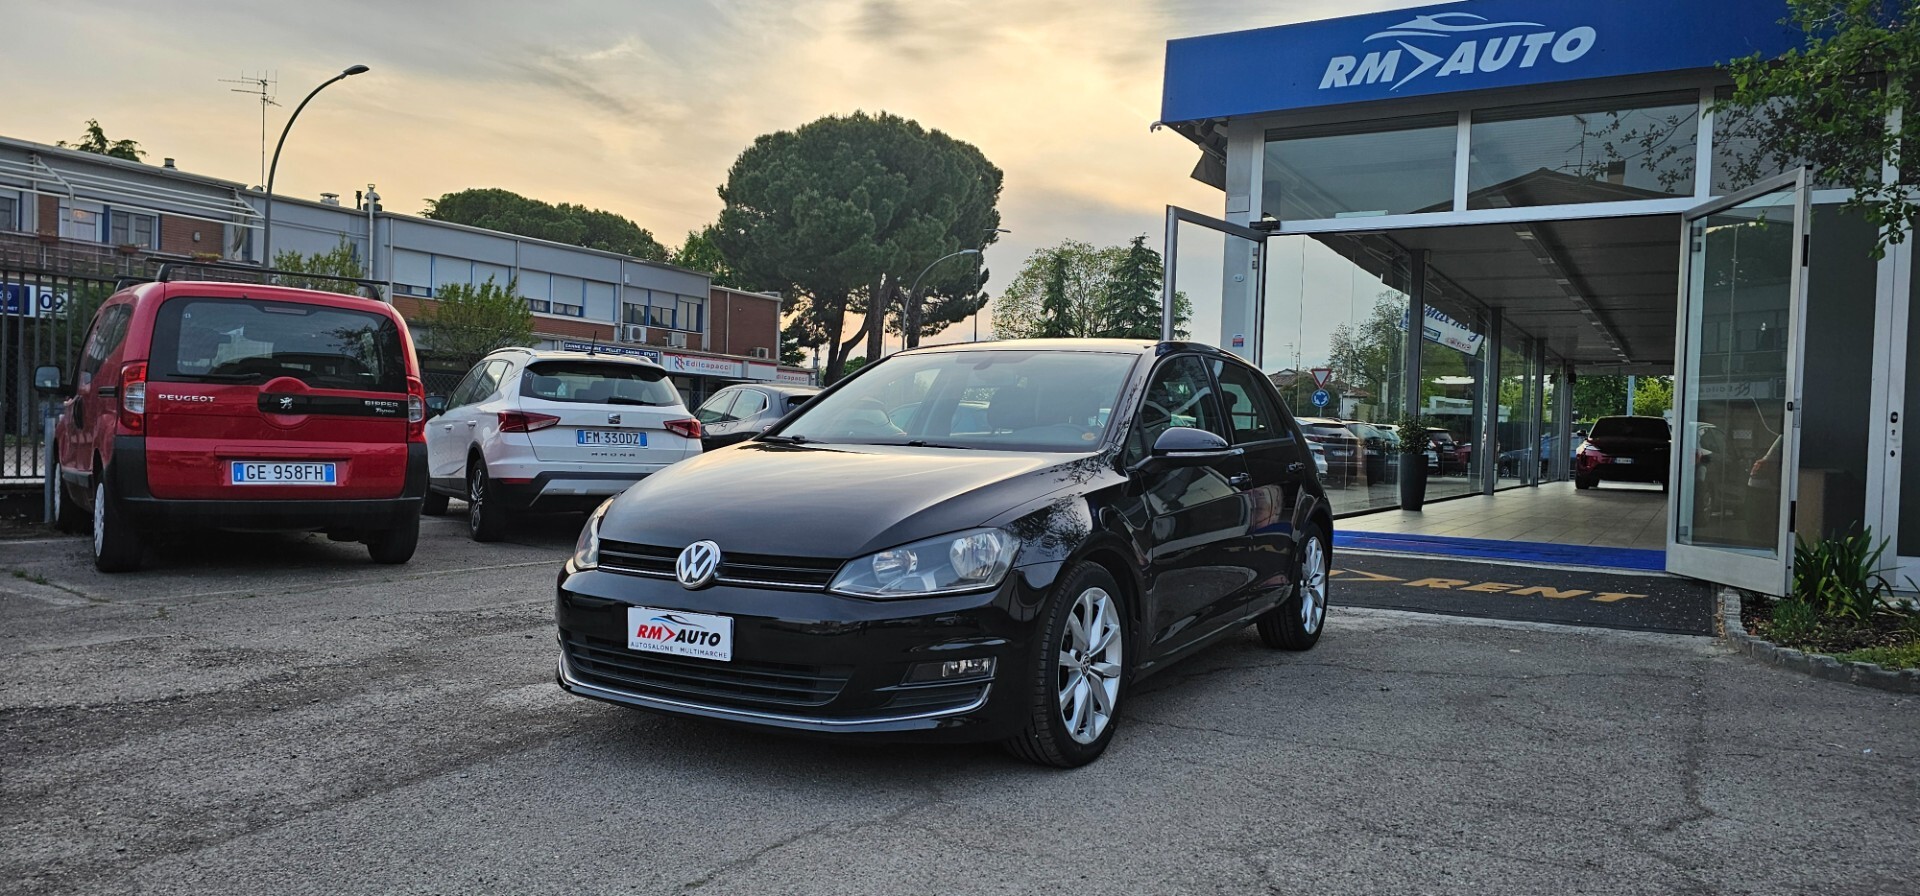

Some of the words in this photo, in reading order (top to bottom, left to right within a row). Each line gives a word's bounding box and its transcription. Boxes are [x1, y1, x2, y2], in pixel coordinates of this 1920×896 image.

[1318, 49, 1402, 90] RM
[1435, 26, 1597, 78] AUTO
[158, 393, 216, 403] PEUGEOT
[585, 431, 600, 443] FM
[604, 432, 639, 445] 330DZ
[246, 464, 267, 480] GE
[273, 464, 324, 481] 958FH
[1402, 577, 1649, 602] RENT
[636, 624, 663, 640] RM
[674, 628, 721, 647] AUTO
[630, 641, 674, 652] AUTOSALONE
[680, 646, 727, 658] MULTIMARCHE
